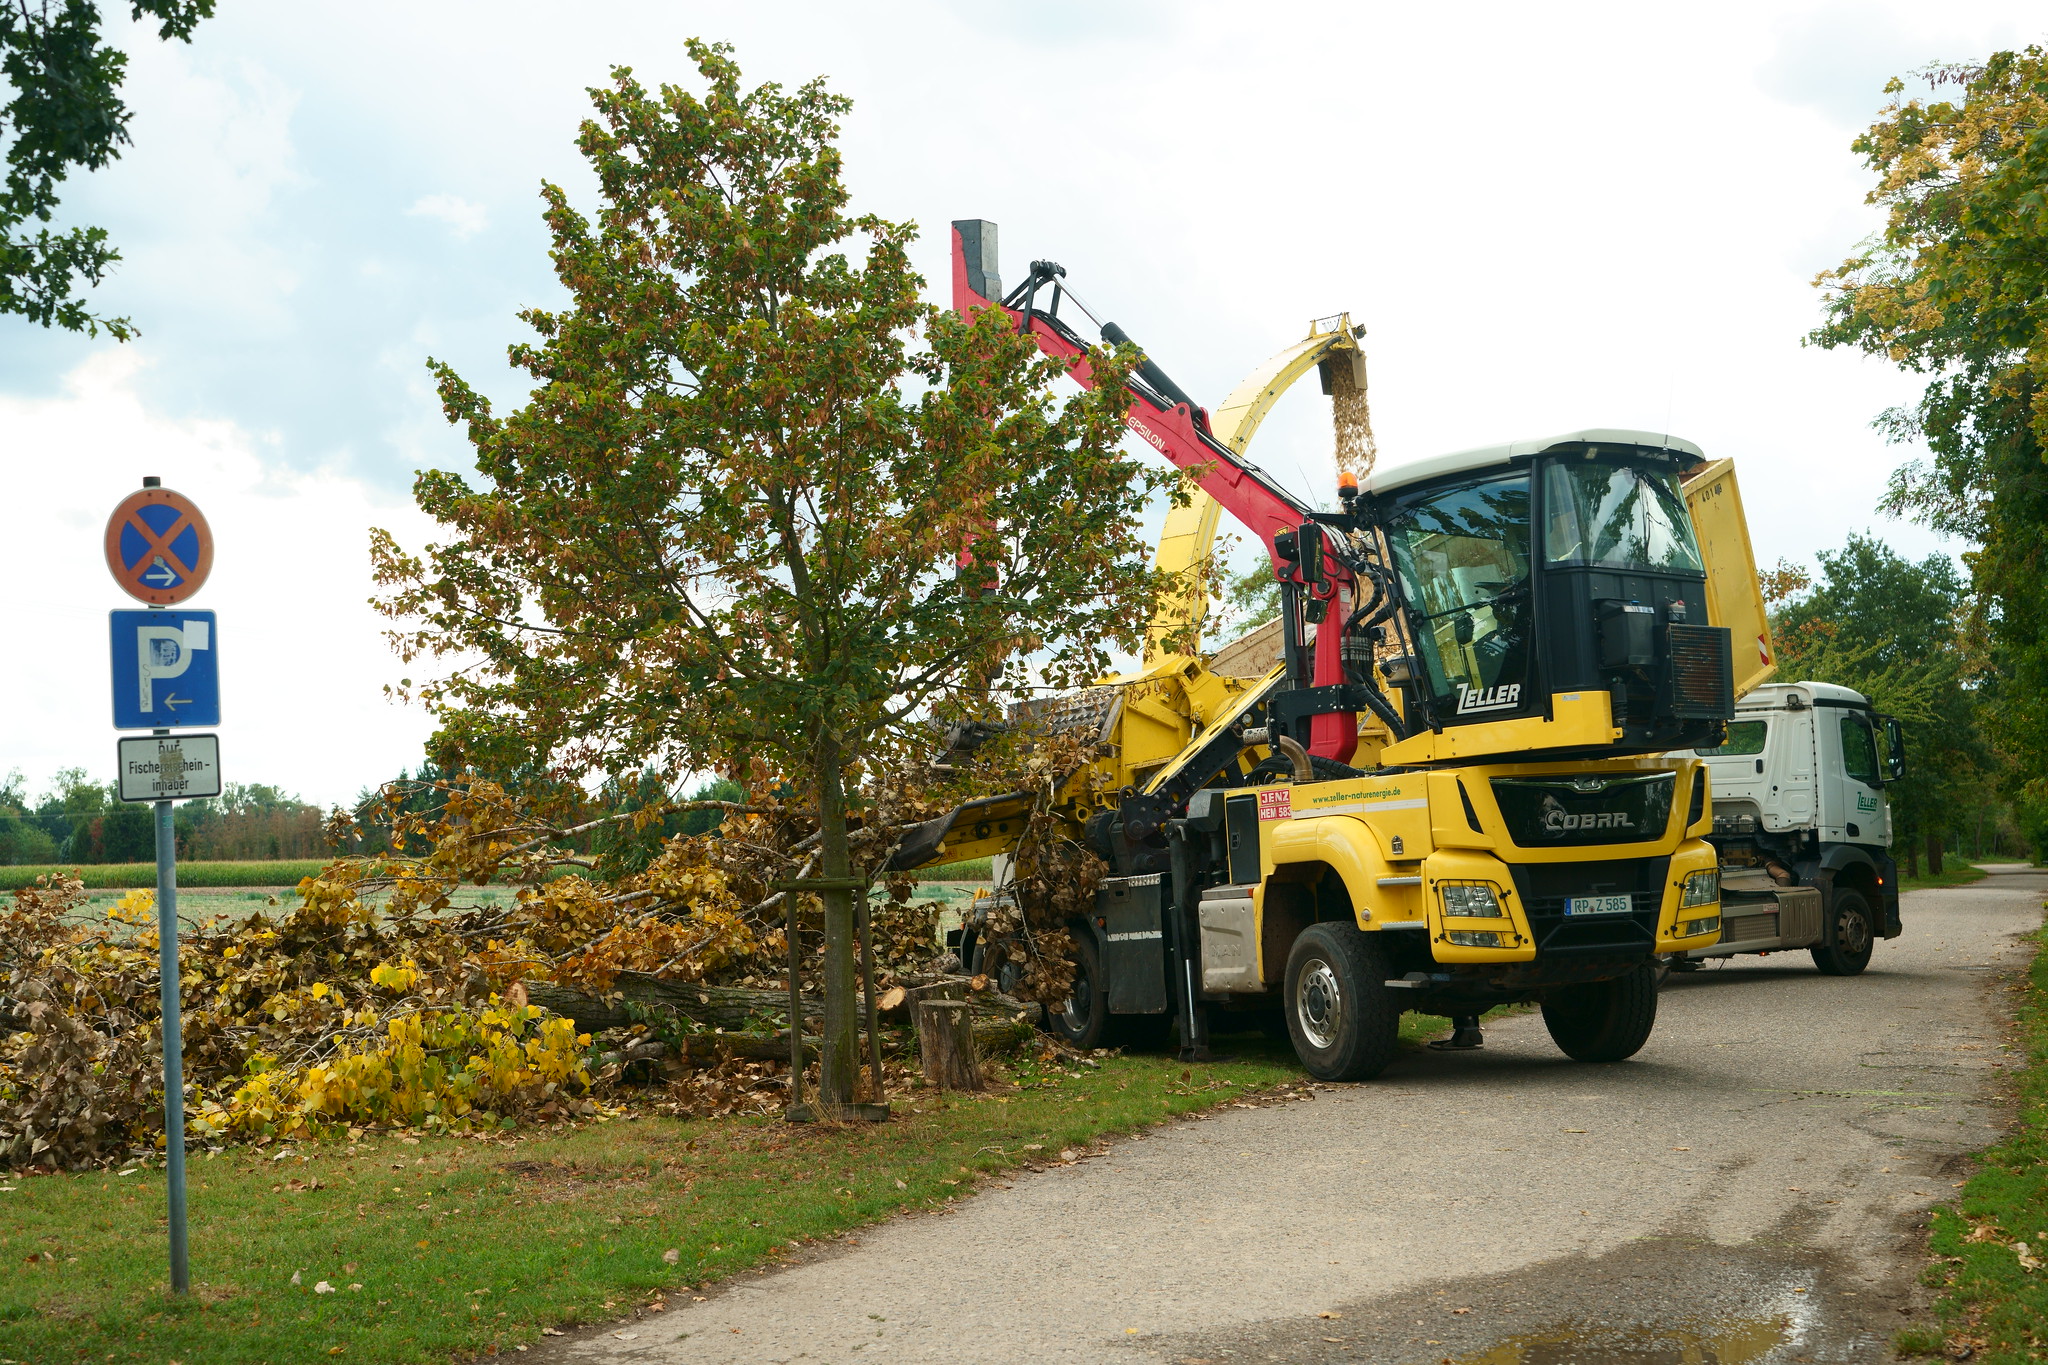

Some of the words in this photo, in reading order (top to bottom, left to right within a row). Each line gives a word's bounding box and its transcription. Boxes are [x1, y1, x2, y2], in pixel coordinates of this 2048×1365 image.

[1128, 416, 1166, 450] EPSILON
[137, 626, 192, 712] P
[1456, 682, 1520, 714] ZELLER
[152, 778, 189, 791] inhaber
[1261, 791, 1289, 804] JENZ
[1312, 787, 1401, 803] www.zeller-naturenergie.de
[1857, 791, 1878, 812] ZELLER
[1260, 807, 1277, 819] HEM
[1278, 806, 1291, 817] 583
[1545, 809, 1635, 831] COBRA
[1574, 899, 1589, 913] RP
[1596, 899, 1603, 912] Z
[1606, 898, 1627, 911] 585
